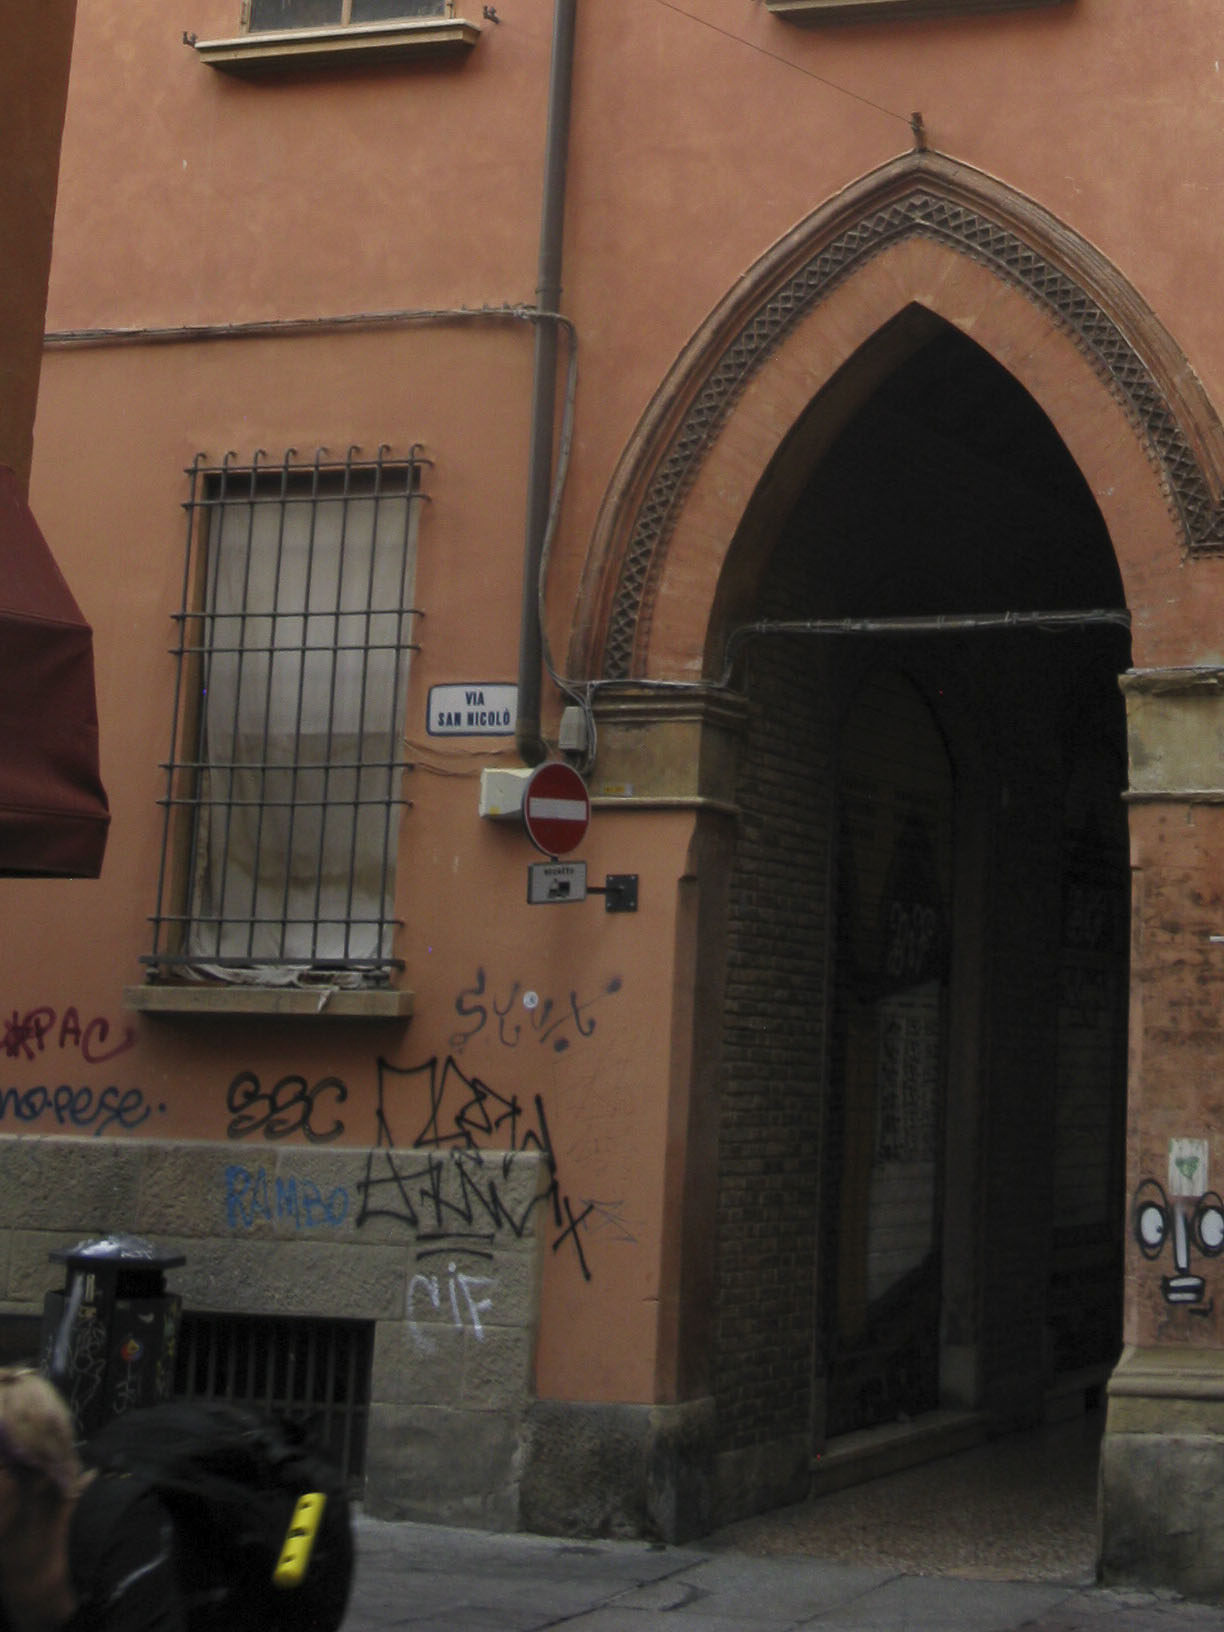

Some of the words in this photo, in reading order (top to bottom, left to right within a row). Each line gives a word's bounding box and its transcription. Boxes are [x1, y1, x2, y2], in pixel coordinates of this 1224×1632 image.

[465, 690, 486, 707] VIA
[438, 711, 462, 727] SAN
[467, 707, 511, 727] NICOLÒ
[224, 1164, 350, 1229] RAMBO
